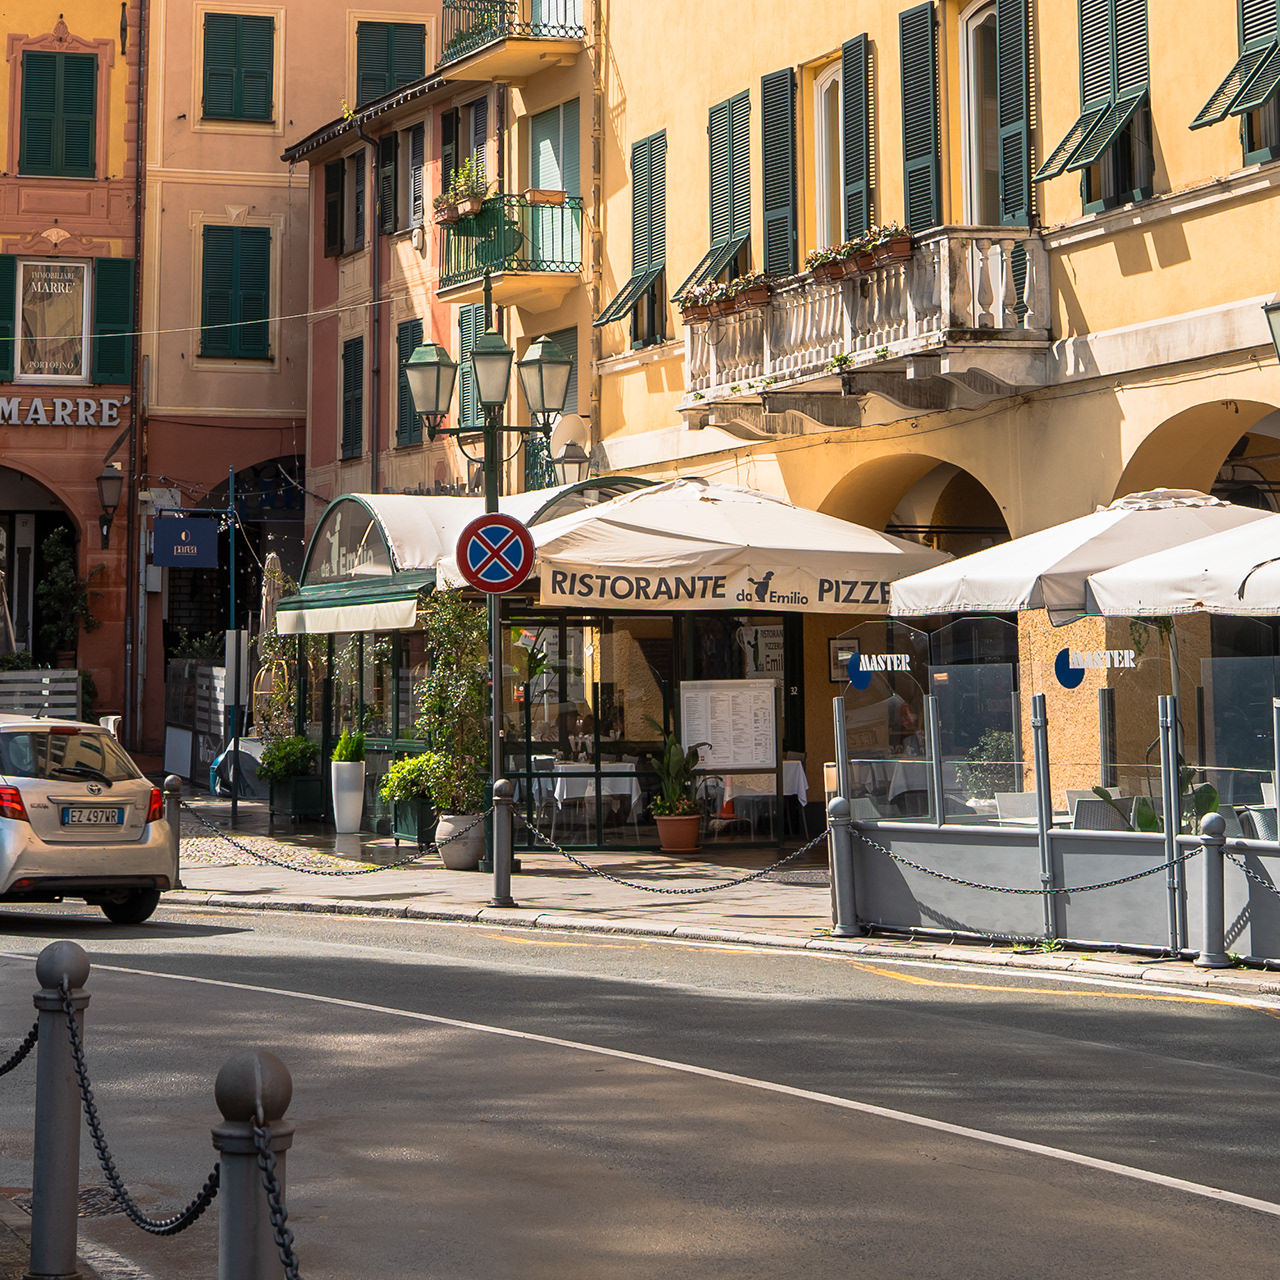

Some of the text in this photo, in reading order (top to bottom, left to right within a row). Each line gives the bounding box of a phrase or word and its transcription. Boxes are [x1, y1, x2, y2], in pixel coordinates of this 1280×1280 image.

[28, 361, 74, 369] PORTOFINO
[551, 570, 891, 605] RISTORANTE da Emilio PIZZE
[859, 653, 911, 672] MASTER
[1069, 649, 1136, 670] MASTER
[790, 686, 798, 695] 32
[70, 810, 117, 823] EZ 497WR
